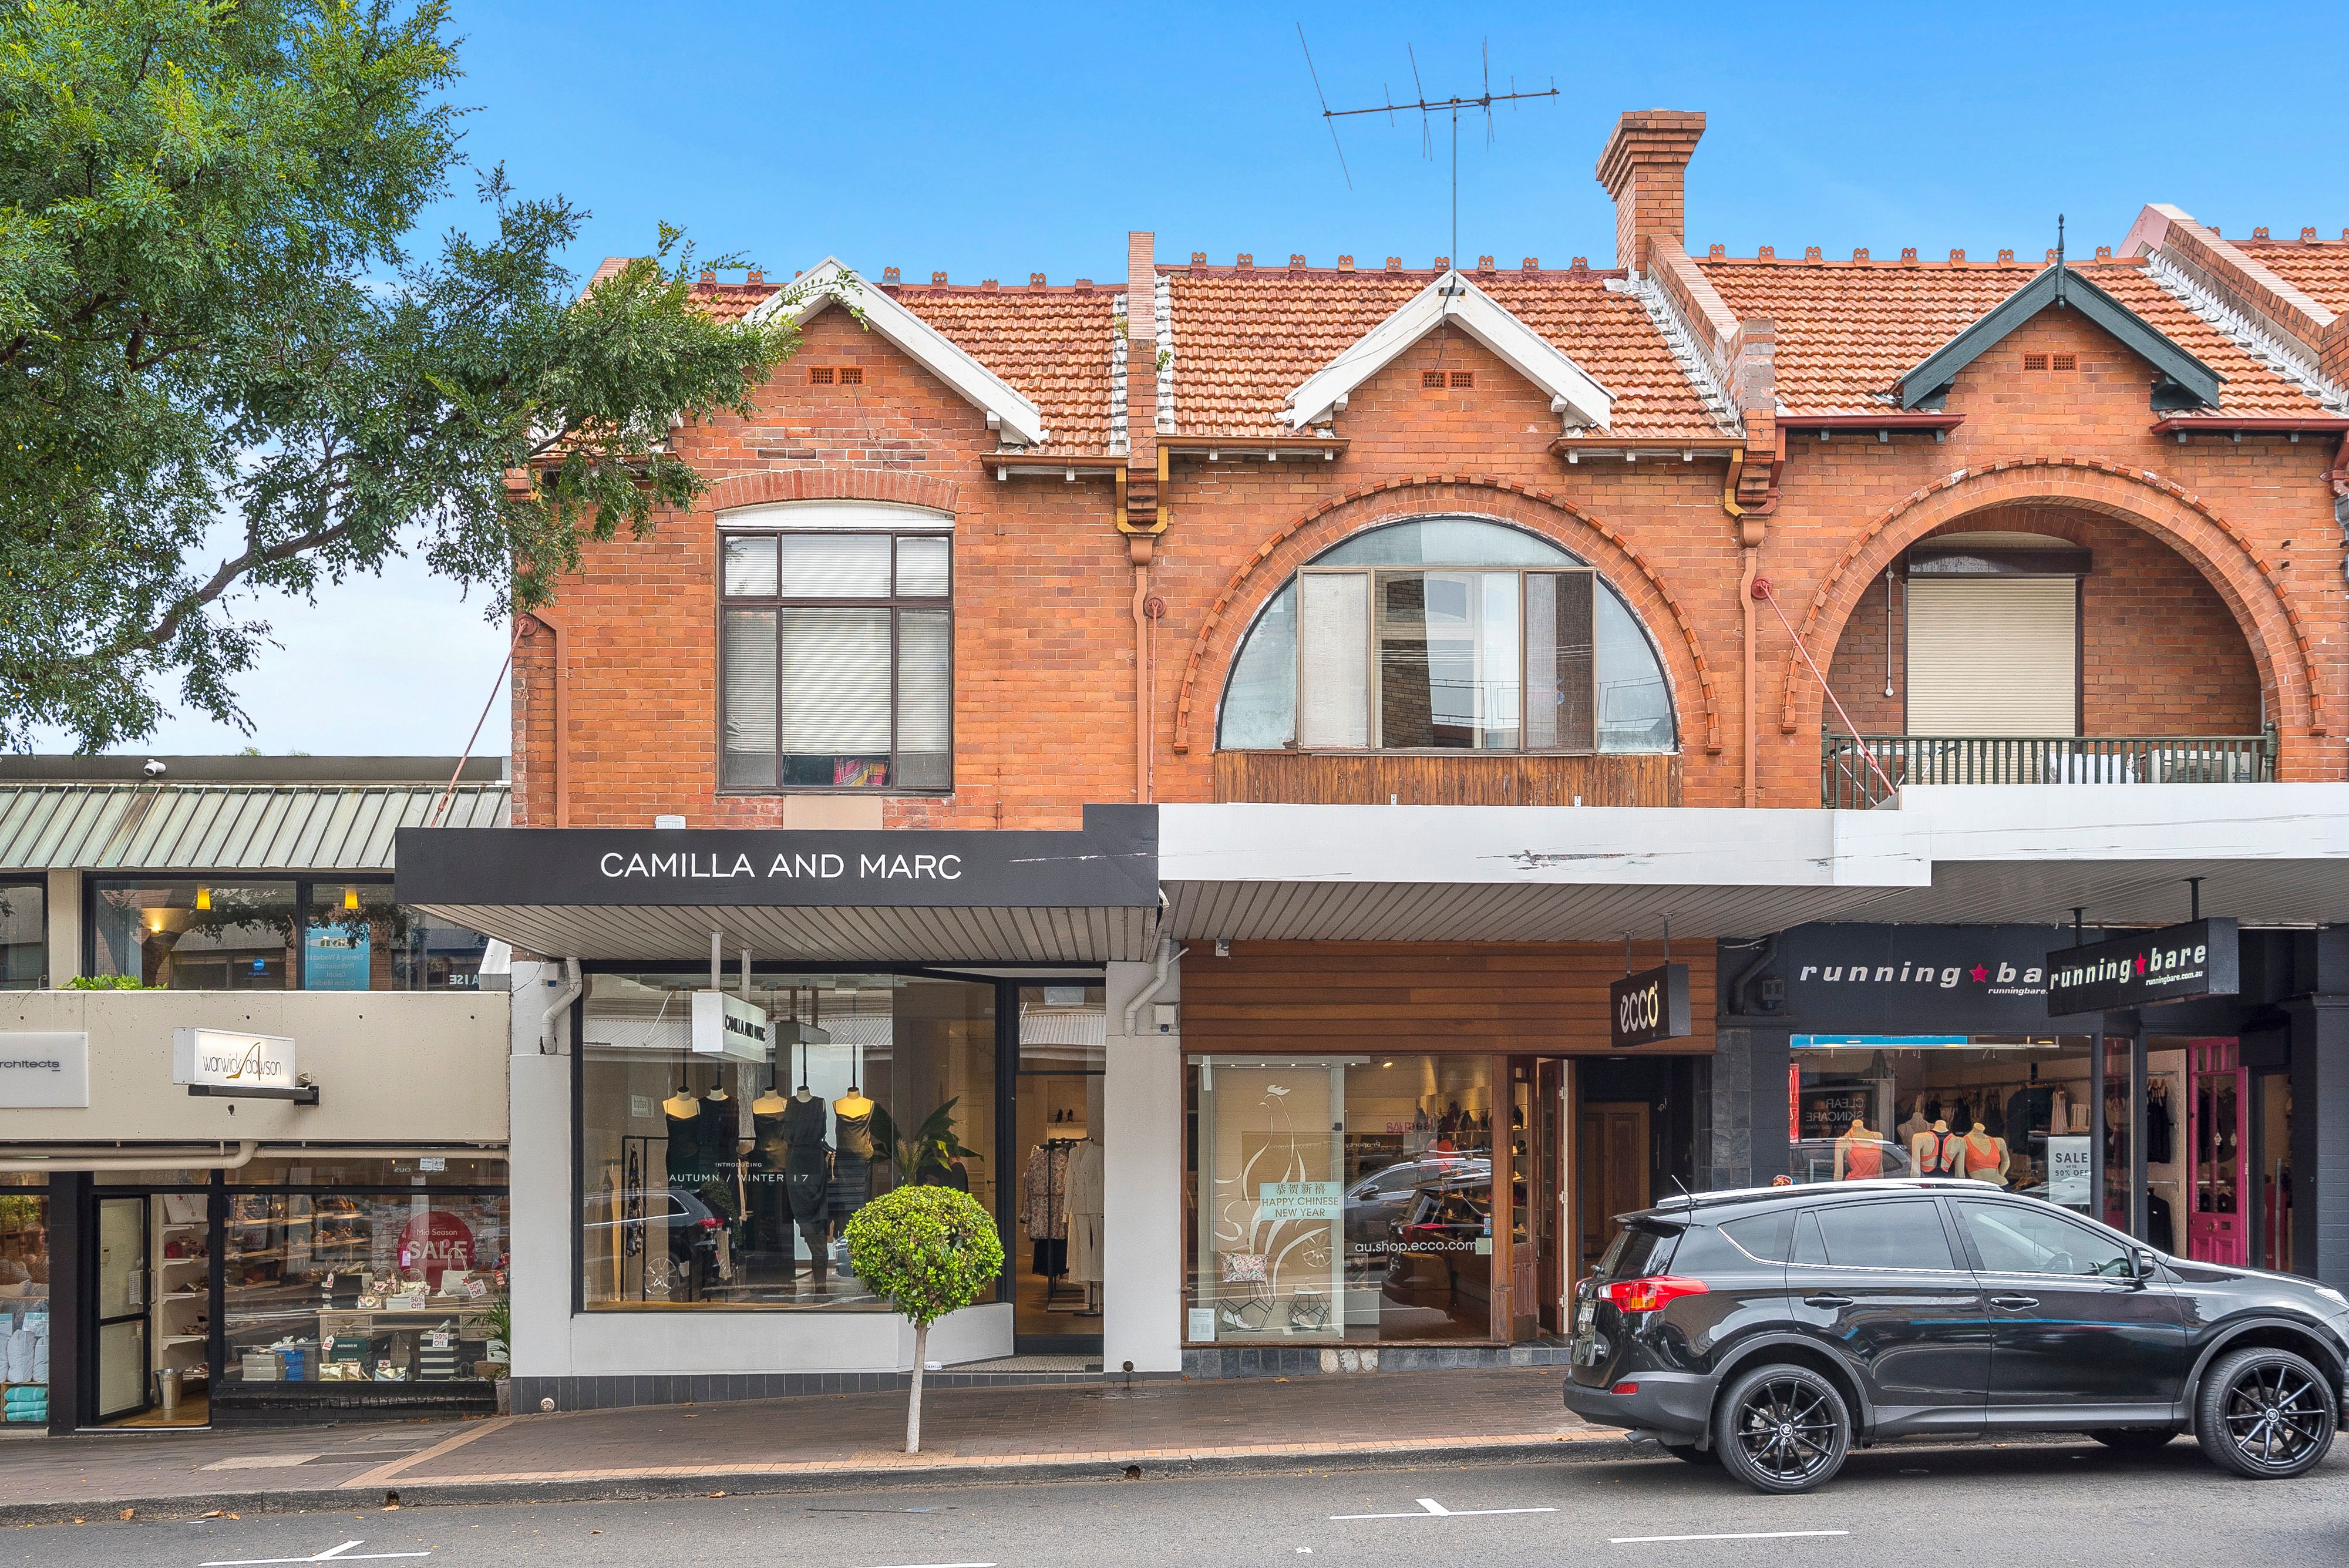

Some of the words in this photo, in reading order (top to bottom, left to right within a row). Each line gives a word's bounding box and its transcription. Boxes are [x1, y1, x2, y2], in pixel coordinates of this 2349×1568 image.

[600, 852, 756, 878] CAMILLA
[767, 853, 844, 879] AND
[860, 854, 962, 880] MARC
[2050, 958, 2132, 990] running
[2149, 944, 2206, 972] bare
[1799, 961, 1961, 988] running
[1997, 962, 2042, 982] ba
[2145, 971, 2203, 986] runningbare.com.au
[203, 1052, 242, 1074] warwick
[245, 1053, 282, 1076] dawson
[2055, 1152, 2088, 1163] SALE
[668, 1174, 719, 1182] AUTUMN
[737, 1174, 784, 1182] WINTER
[1275, 1183, 1326, 1195] 恭贺新禧
[1262, 1197, 1294, 1207] HAPPY
[1297, 1196, 1339, 1206] CHINESE
[1275, 1208, 1297, 1217] NEW
[1300, 1207, 1325, 1217] YEAR
[432, 1228, 457, 1236] Season
[407, 1240, 467, 1260] SALE
[1355, 1241, 1476, 1253] au.shop.ecco.com
[469, 1280, 483, 1291] 50%
[472, 1288, 482, 1297] Off
